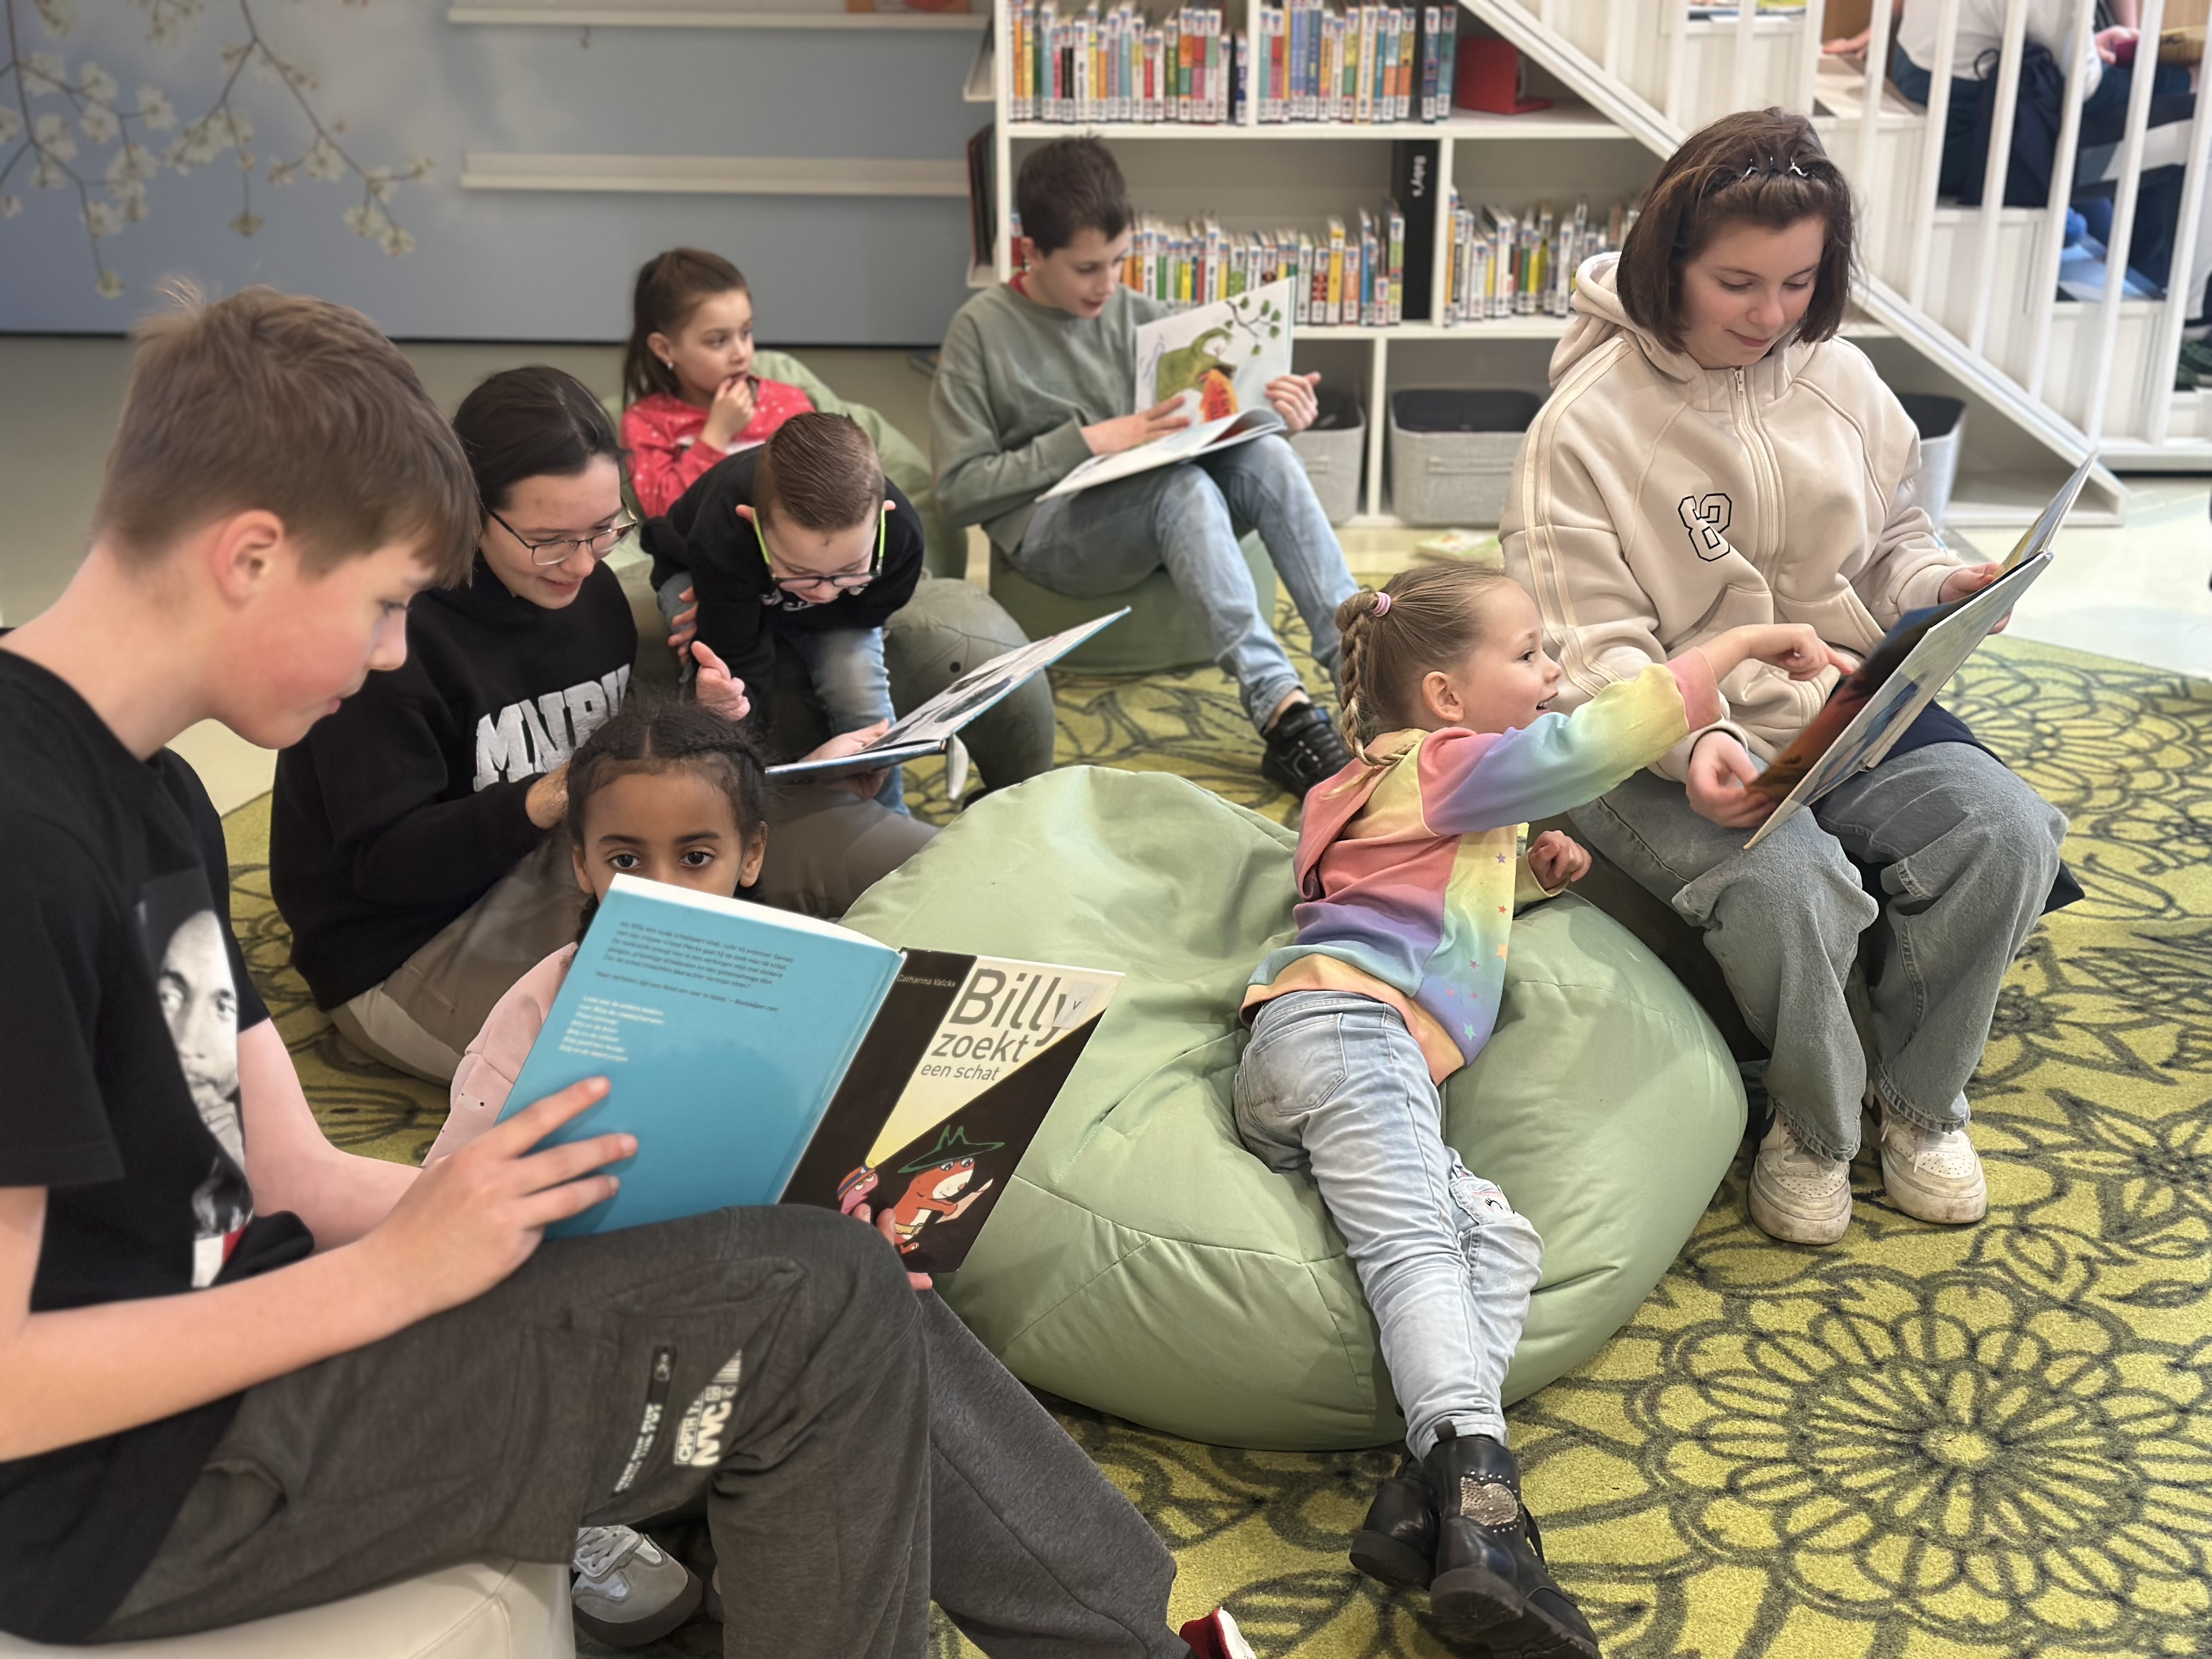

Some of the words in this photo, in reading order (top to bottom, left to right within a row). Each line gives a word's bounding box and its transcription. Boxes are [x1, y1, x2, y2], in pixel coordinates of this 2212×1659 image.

[773, 954, 794, 962] Samen
[896, 974, 932, 986] Catharina
[934, 978, 956, 988] Valckx
[949, 968, 1067, 1047] Billy
[932, 1030, 1029, 1063] zoekt
[921, 1064, 951, 1077] een
[956, 1064, 1000, 1081] schat
